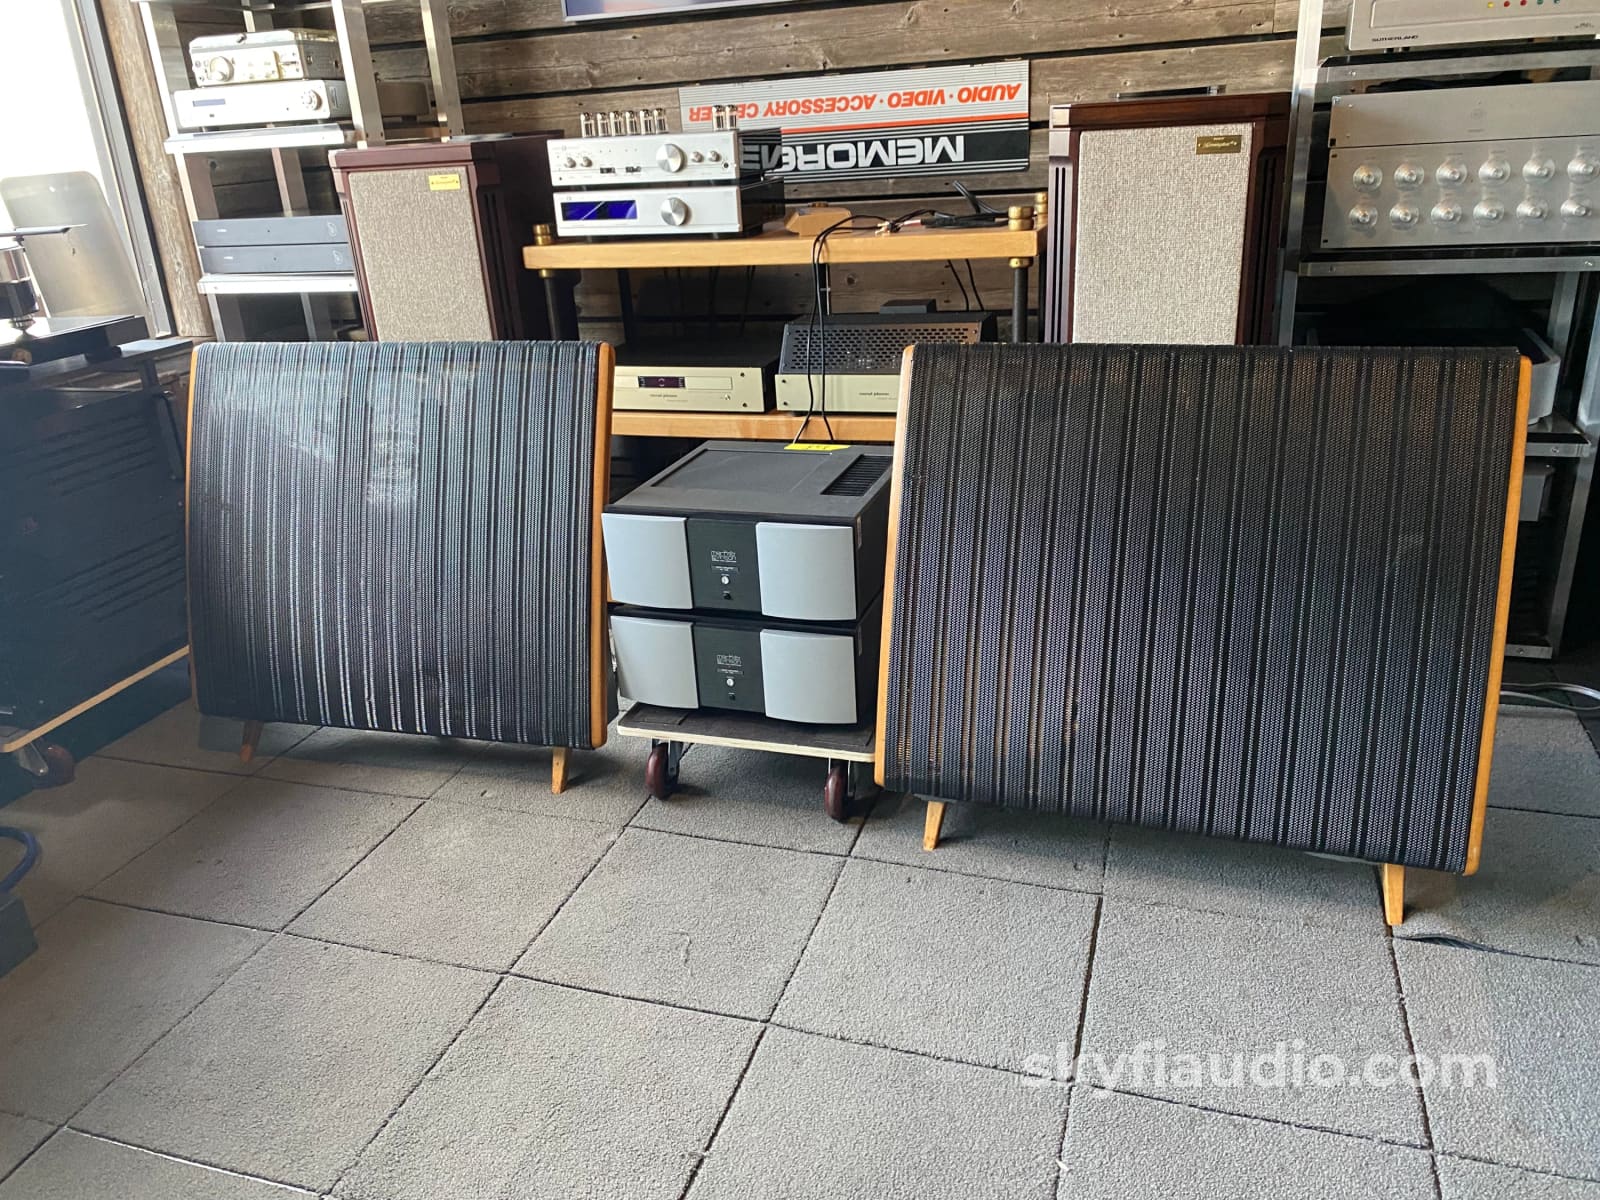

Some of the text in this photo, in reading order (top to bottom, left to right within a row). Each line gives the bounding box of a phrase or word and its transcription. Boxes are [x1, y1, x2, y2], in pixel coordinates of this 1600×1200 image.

[689, 83, 1022, 122] AUDIO VIDEO ACCESSORY CEER
[766, 135, 965, 173] MEMORE
